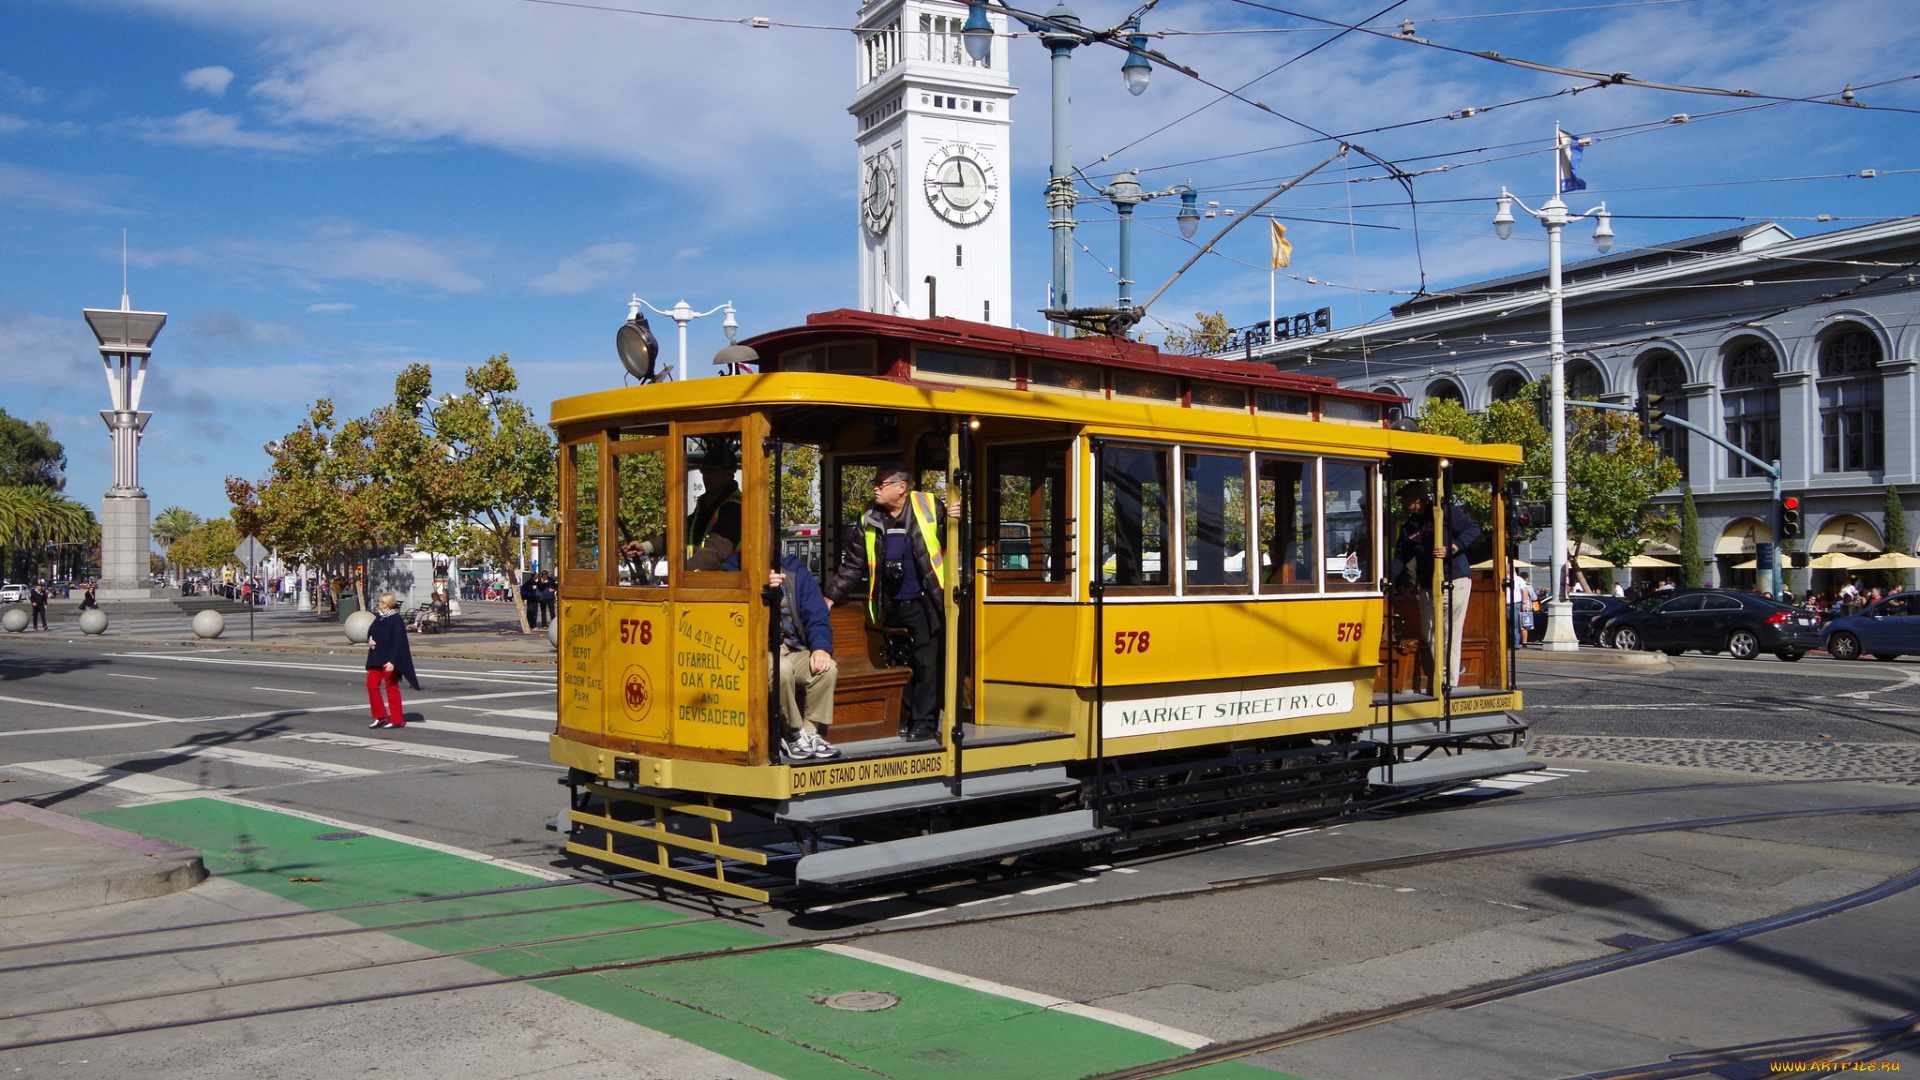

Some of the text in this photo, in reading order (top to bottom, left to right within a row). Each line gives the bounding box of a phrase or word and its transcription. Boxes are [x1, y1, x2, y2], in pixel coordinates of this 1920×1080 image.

[620, 618, 652, 645] 578
[1114, 630, 1150, 654] 578
[1337, 622, 1362, 642] 578
[573, 646, 591, 659] DEPOT
[678, 617, 692, 640] VIA
[714, 635, 748, 671] ELLIS
[678, 651, 722, 670] O'FARRELL
[681, 671, 741, 691] OAK PAGE
[701, 693, 720, 705] AND
[679, 704, 746, 727] DEVISADERO
[1120, 704, 1206, 726] MARKET
[1214, 697, 1286, 718] STREET
[794, 756, 942, 789] DO NOT STAND ON RUNNING BOARDS
